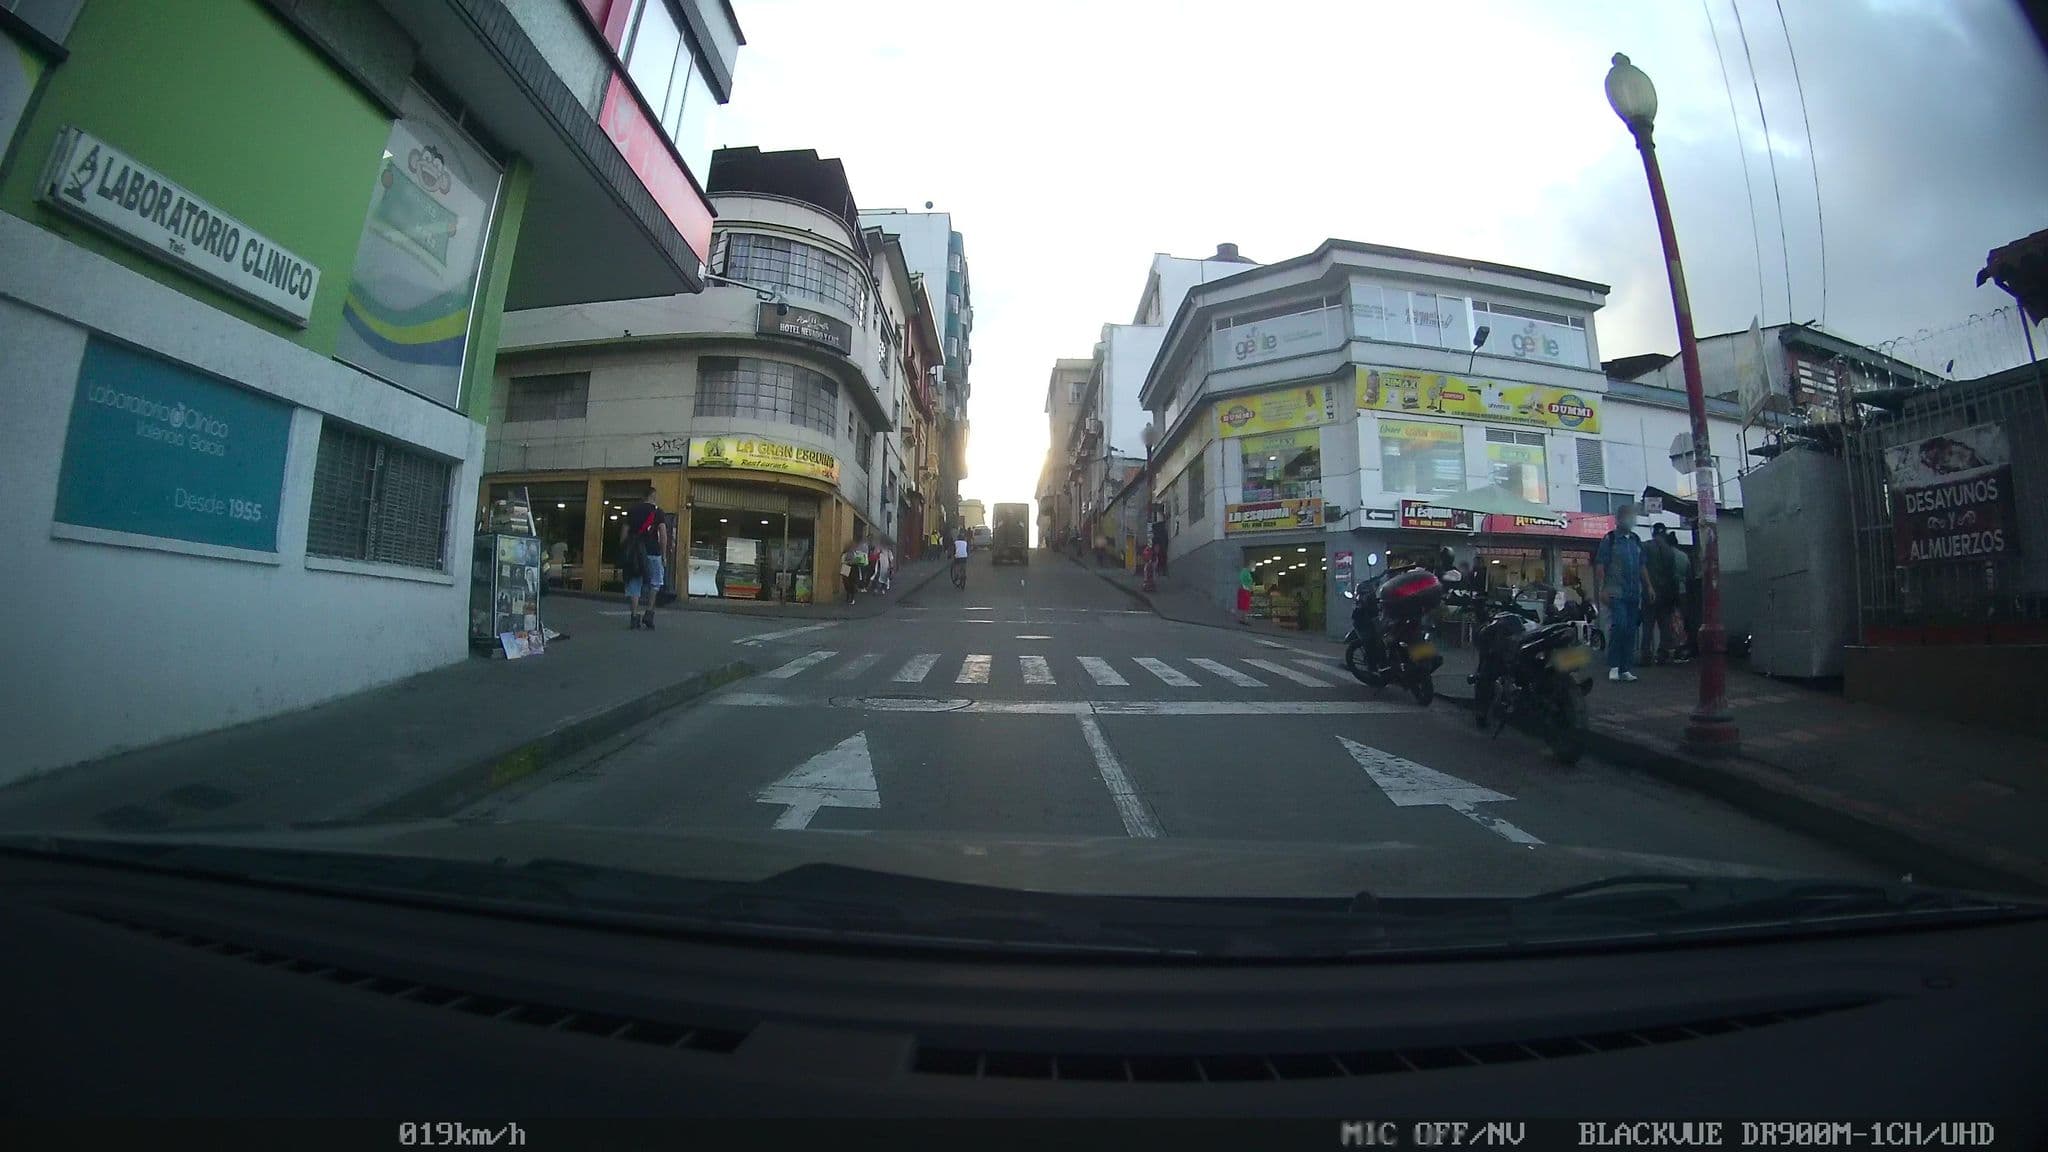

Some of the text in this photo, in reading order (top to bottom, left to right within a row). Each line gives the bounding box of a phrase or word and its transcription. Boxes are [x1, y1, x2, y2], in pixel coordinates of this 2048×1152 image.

[96, 156, 240, 263] LABORATORIO
[242, 238, 312, 300] CLINICO
[779, 322, 800, 335] HOTEL
[89, 383, 169, 421] Laboratorio
[1551, 404, 1591, 417] DUMMI
[736, 439, 754, 453] LA
[757, 441, 793, 459] GRAN
[174, 487, 262, 521] Desde 1955
[1905, 478, 1998, 514] DESAYUNOS
[1949, 512, 1956, 530] Y
[1910, 529, 2005, 561] ALMUERZOS
